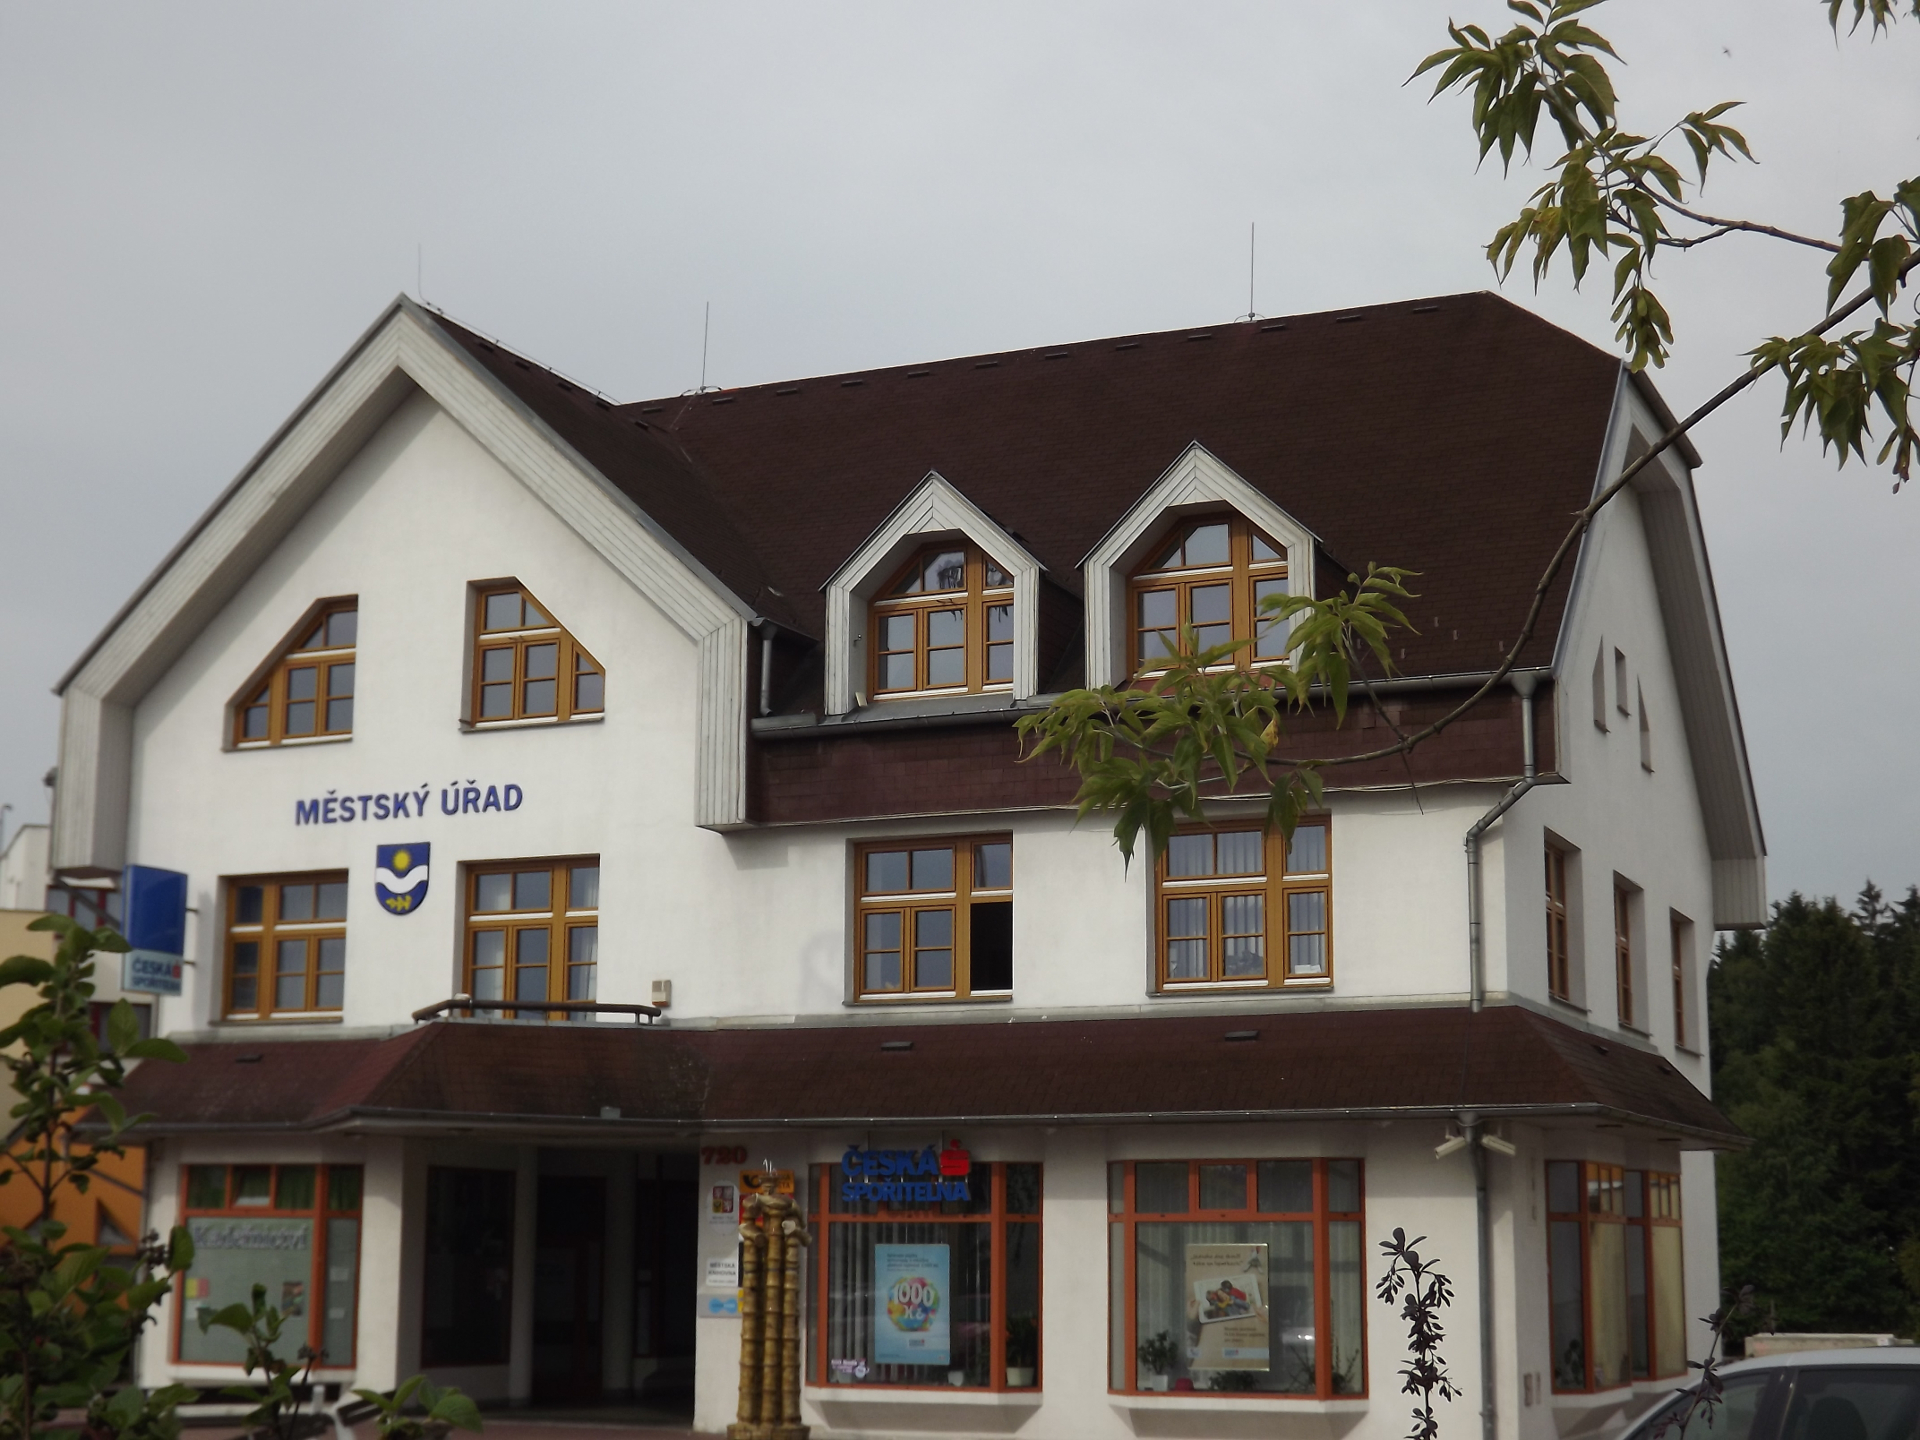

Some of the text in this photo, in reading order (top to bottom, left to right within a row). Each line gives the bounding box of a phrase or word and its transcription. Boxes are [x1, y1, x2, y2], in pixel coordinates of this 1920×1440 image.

[295, 779, 523, 826] MĚSTSKÝ ÚŘAD
[842, 1144, 939, 1176] ČESKÁ
[842, 1178, 970, 1202] SPOŘITELNA
[893, 1282, 934, 1308] 1000
